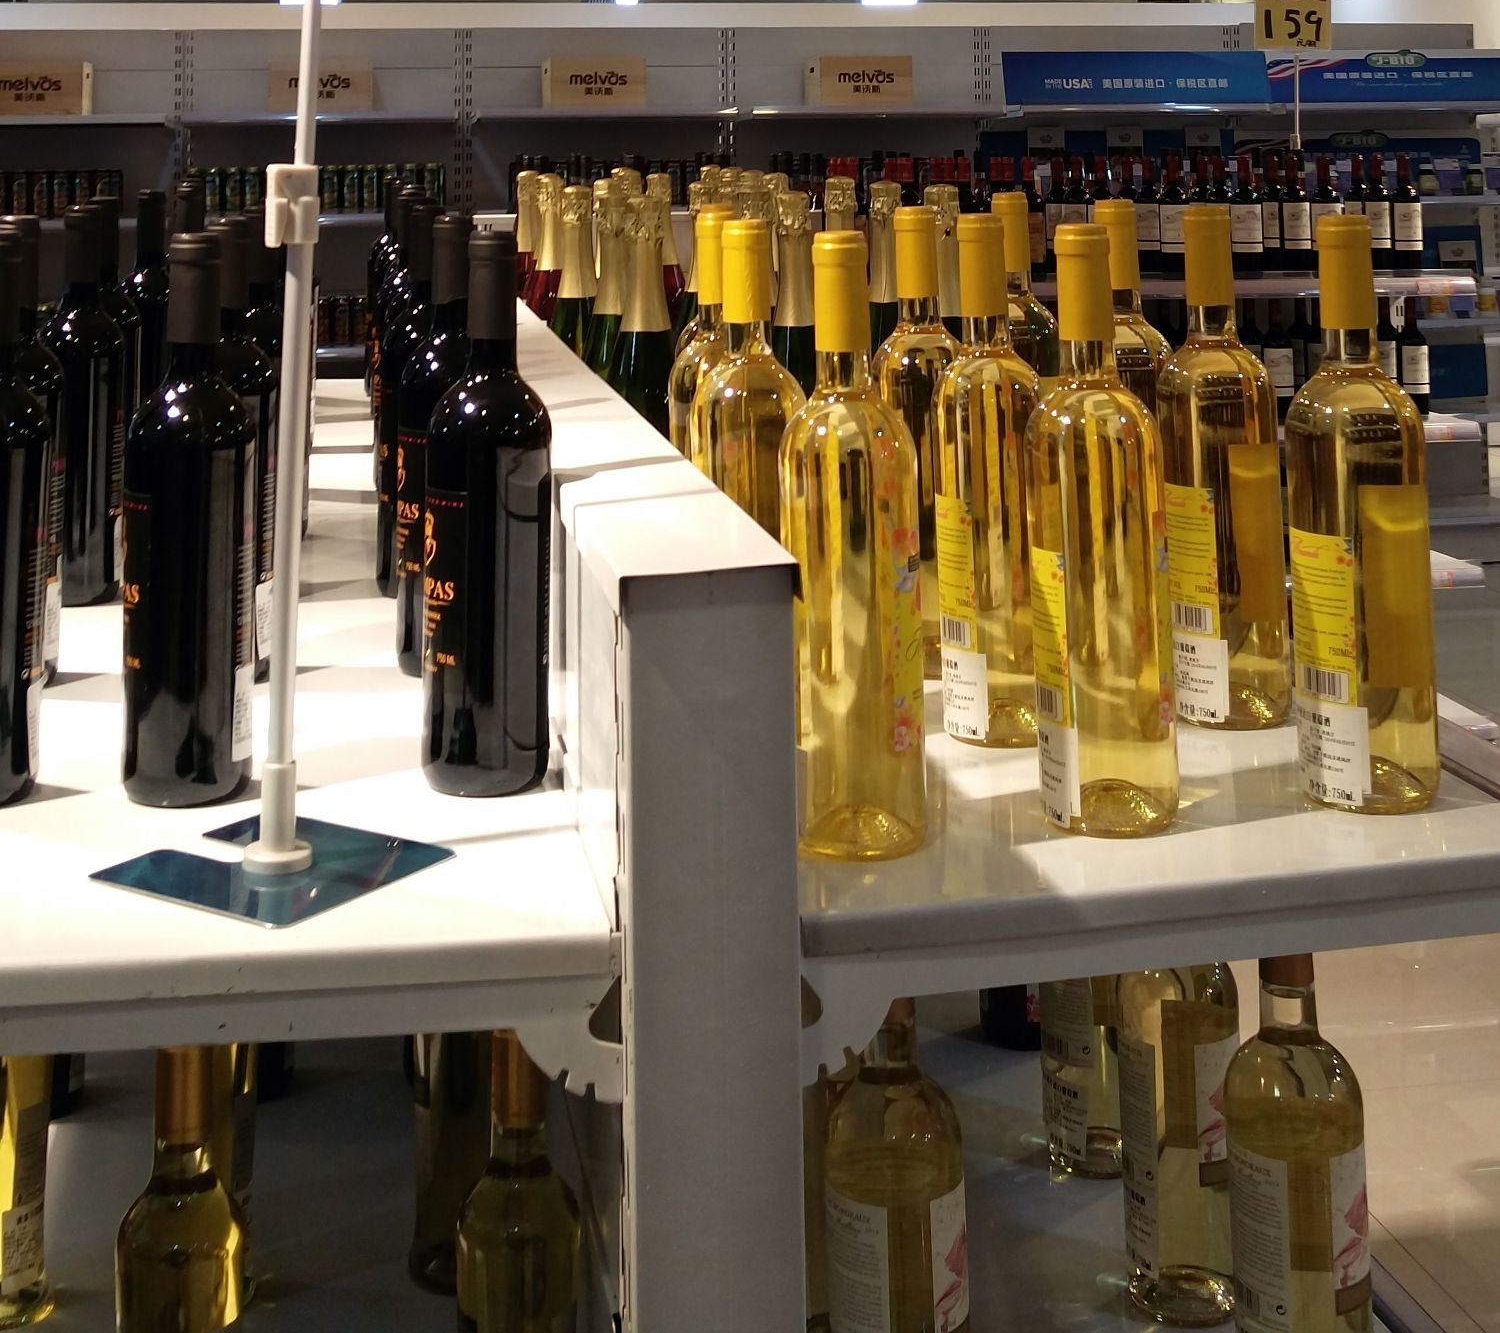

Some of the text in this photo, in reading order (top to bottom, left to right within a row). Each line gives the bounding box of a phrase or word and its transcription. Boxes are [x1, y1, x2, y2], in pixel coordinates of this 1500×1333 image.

[1264, 9, 1323, 41] 159
[288, 74, 351, 89] mvos
[1062, 79, 1090, 89] USA
[425, 576, 455, 601] PAS
